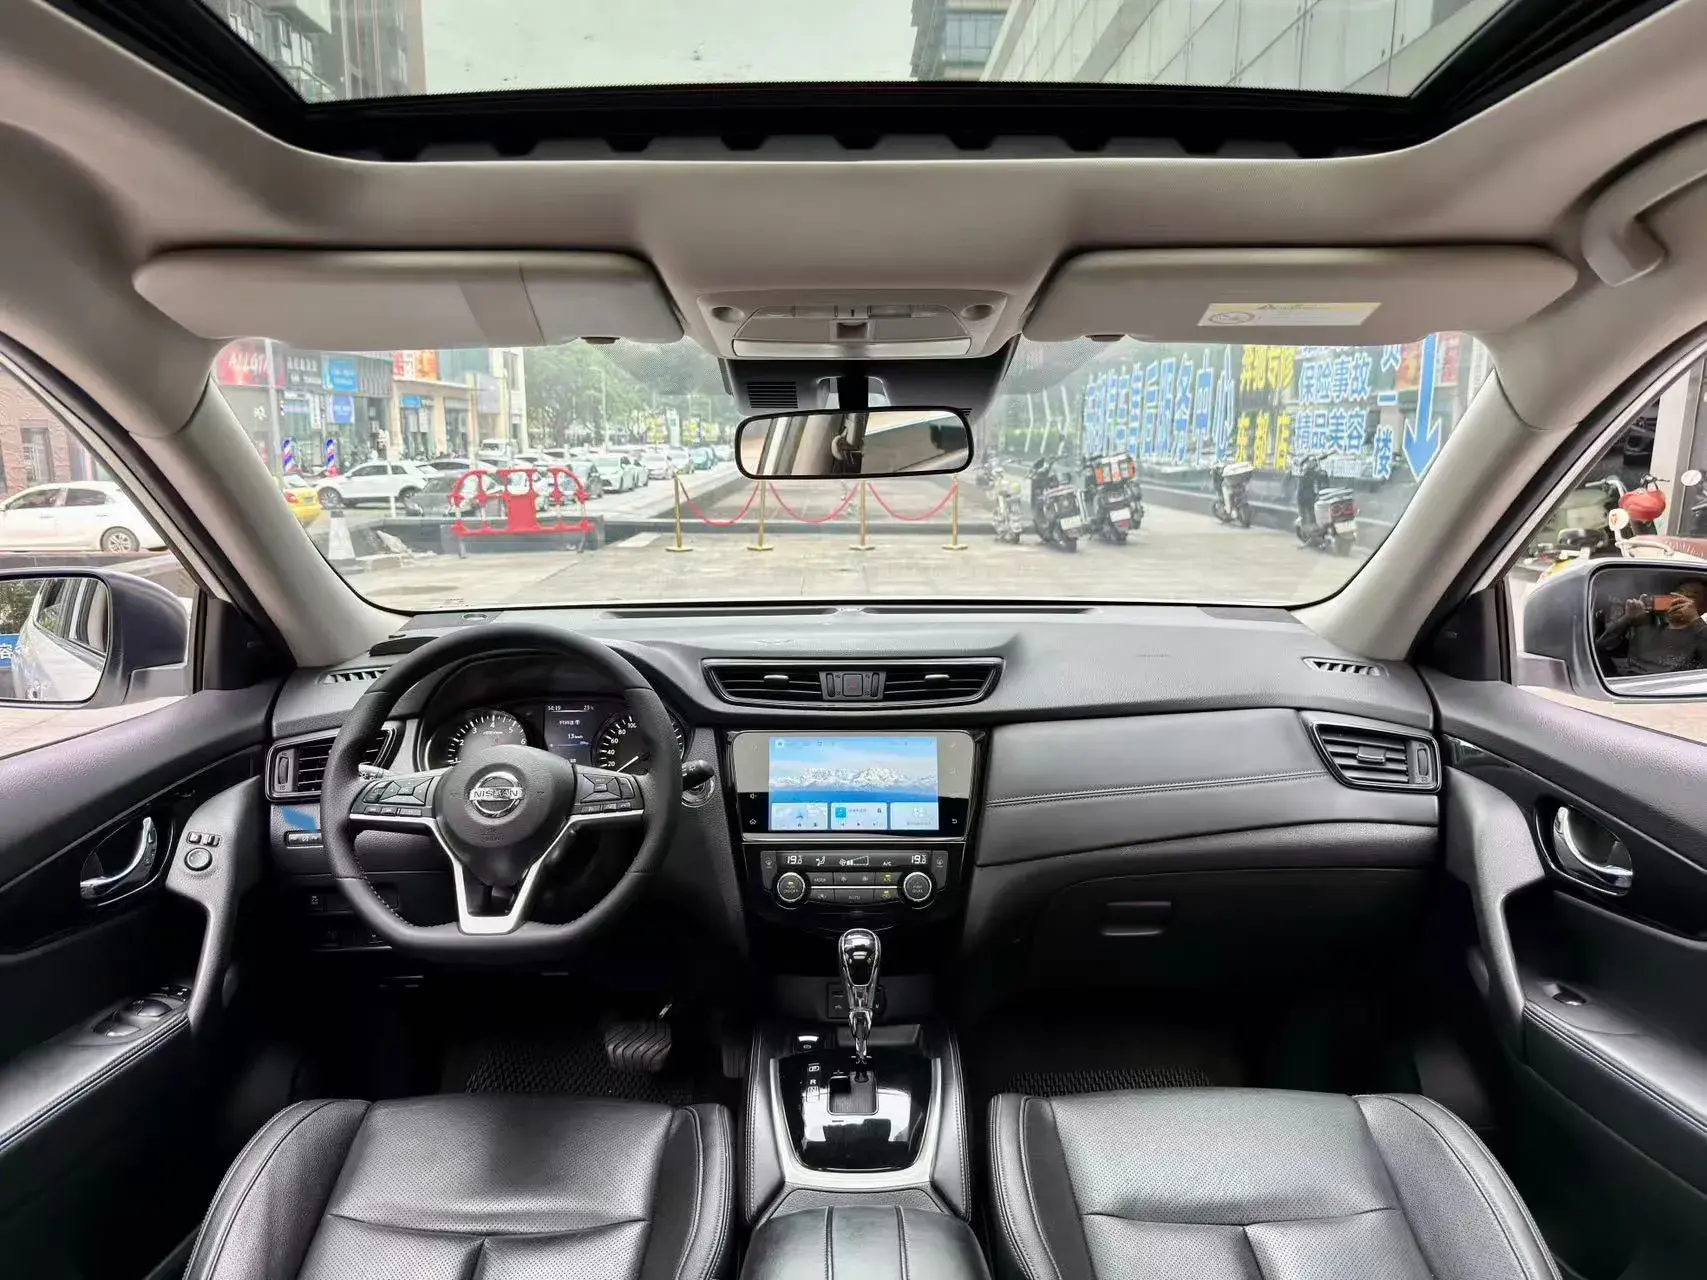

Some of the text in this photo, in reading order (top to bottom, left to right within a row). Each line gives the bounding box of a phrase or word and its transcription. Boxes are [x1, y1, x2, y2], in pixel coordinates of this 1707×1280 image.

[1298, 353, 1373, 404] 保险事故
[473, 789, 518, 798] NISSAN
